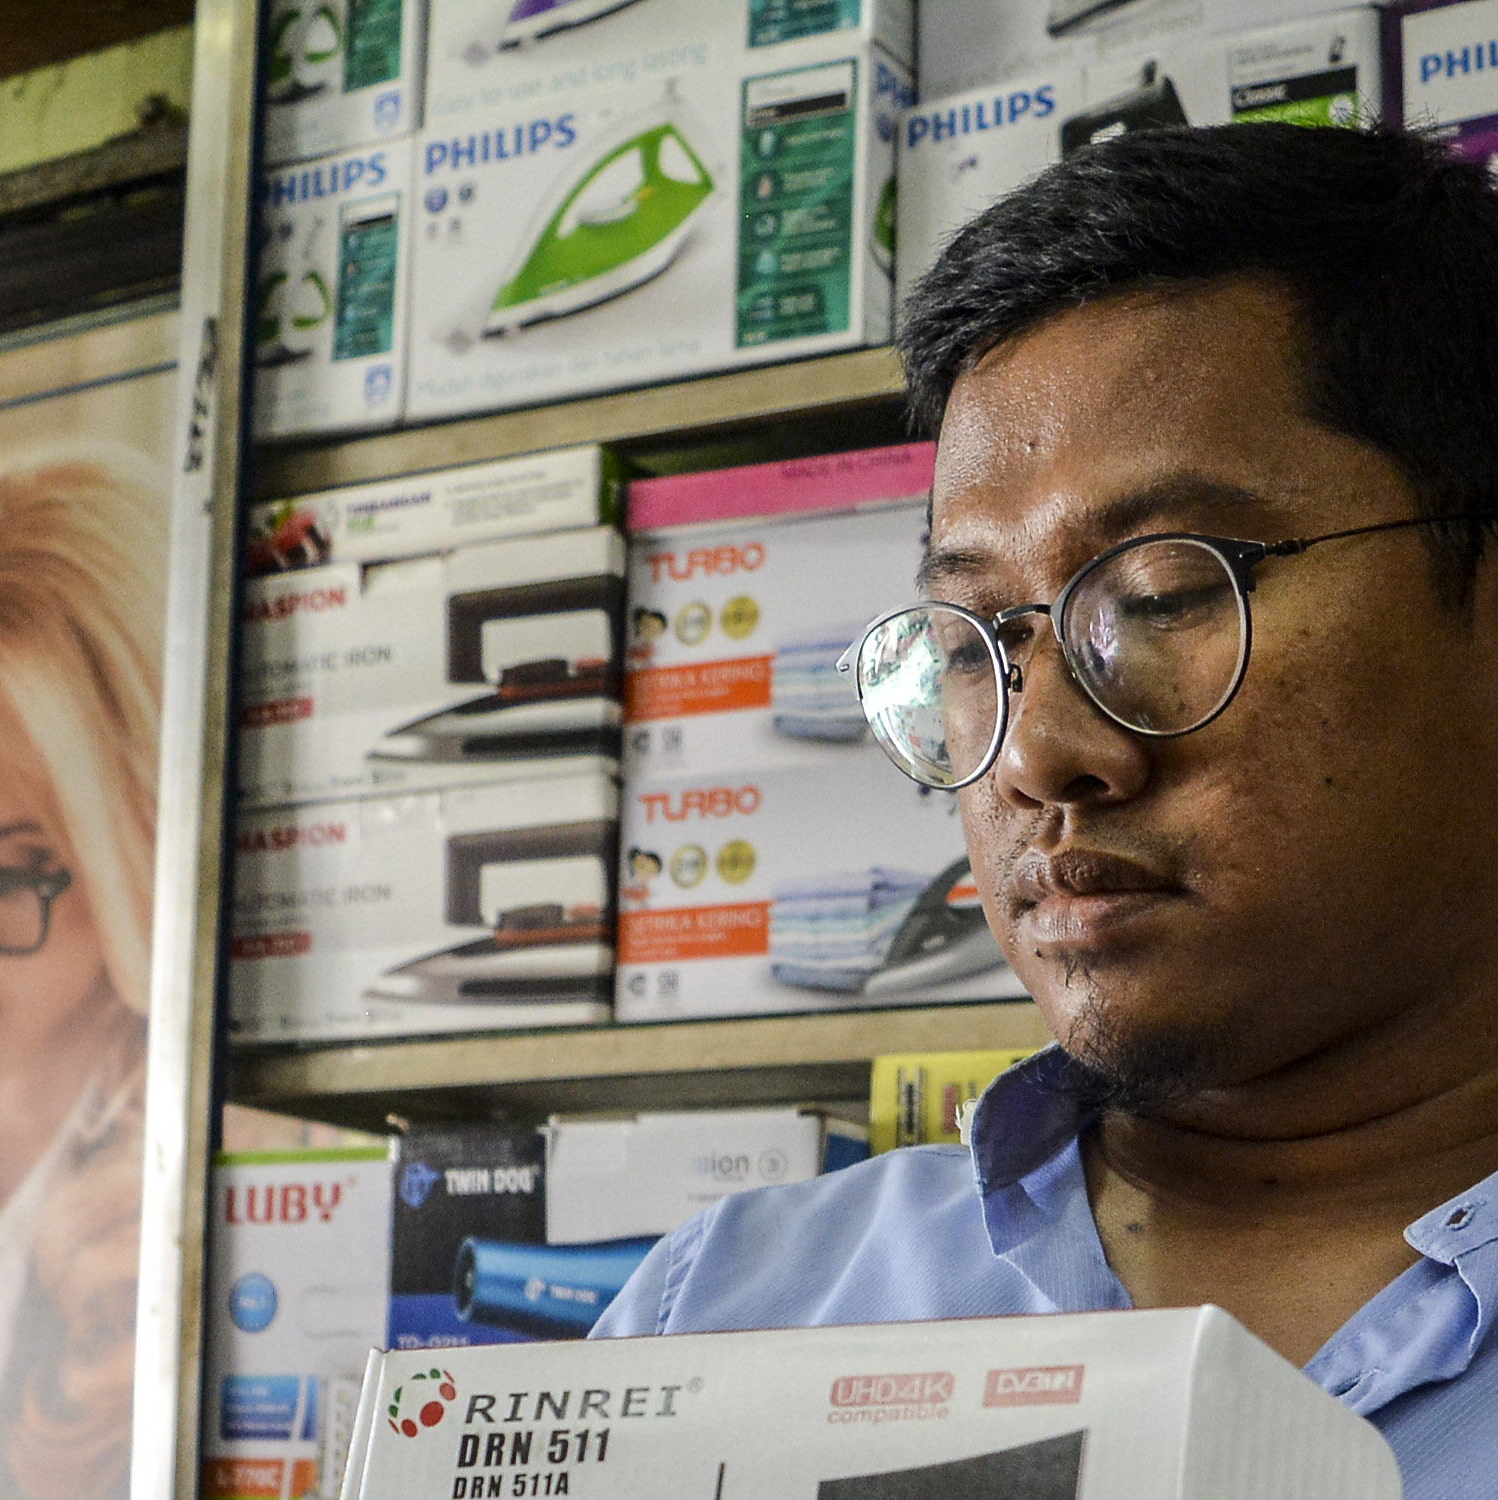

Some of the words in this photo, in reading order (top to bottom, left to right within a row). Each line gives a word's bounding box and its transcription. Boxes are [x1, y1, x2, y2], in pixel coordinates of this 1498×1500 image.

[907, 83, 1057, 149] PHILIPS
[423, 112, 579, 175] PHILIPS
[269, 151, 387, 207] HILIPS
[646, 541, 767, 585] TURBO
[640, 785, 763, 824] TURBO
[445, 1167, 490, 1195] TWIN
[224, 1181, 343, 1226] LUBY
[464, 1385, 683, 1425] RINREI
[827, 1405, 950, 1425] compatible
[456, 1430, 534, 1468] DRN
[547, 1427, 611, 1465] 511
[452, 1474, 504, 1500] DRN
[511, 1471, 571, 1498] 511A
